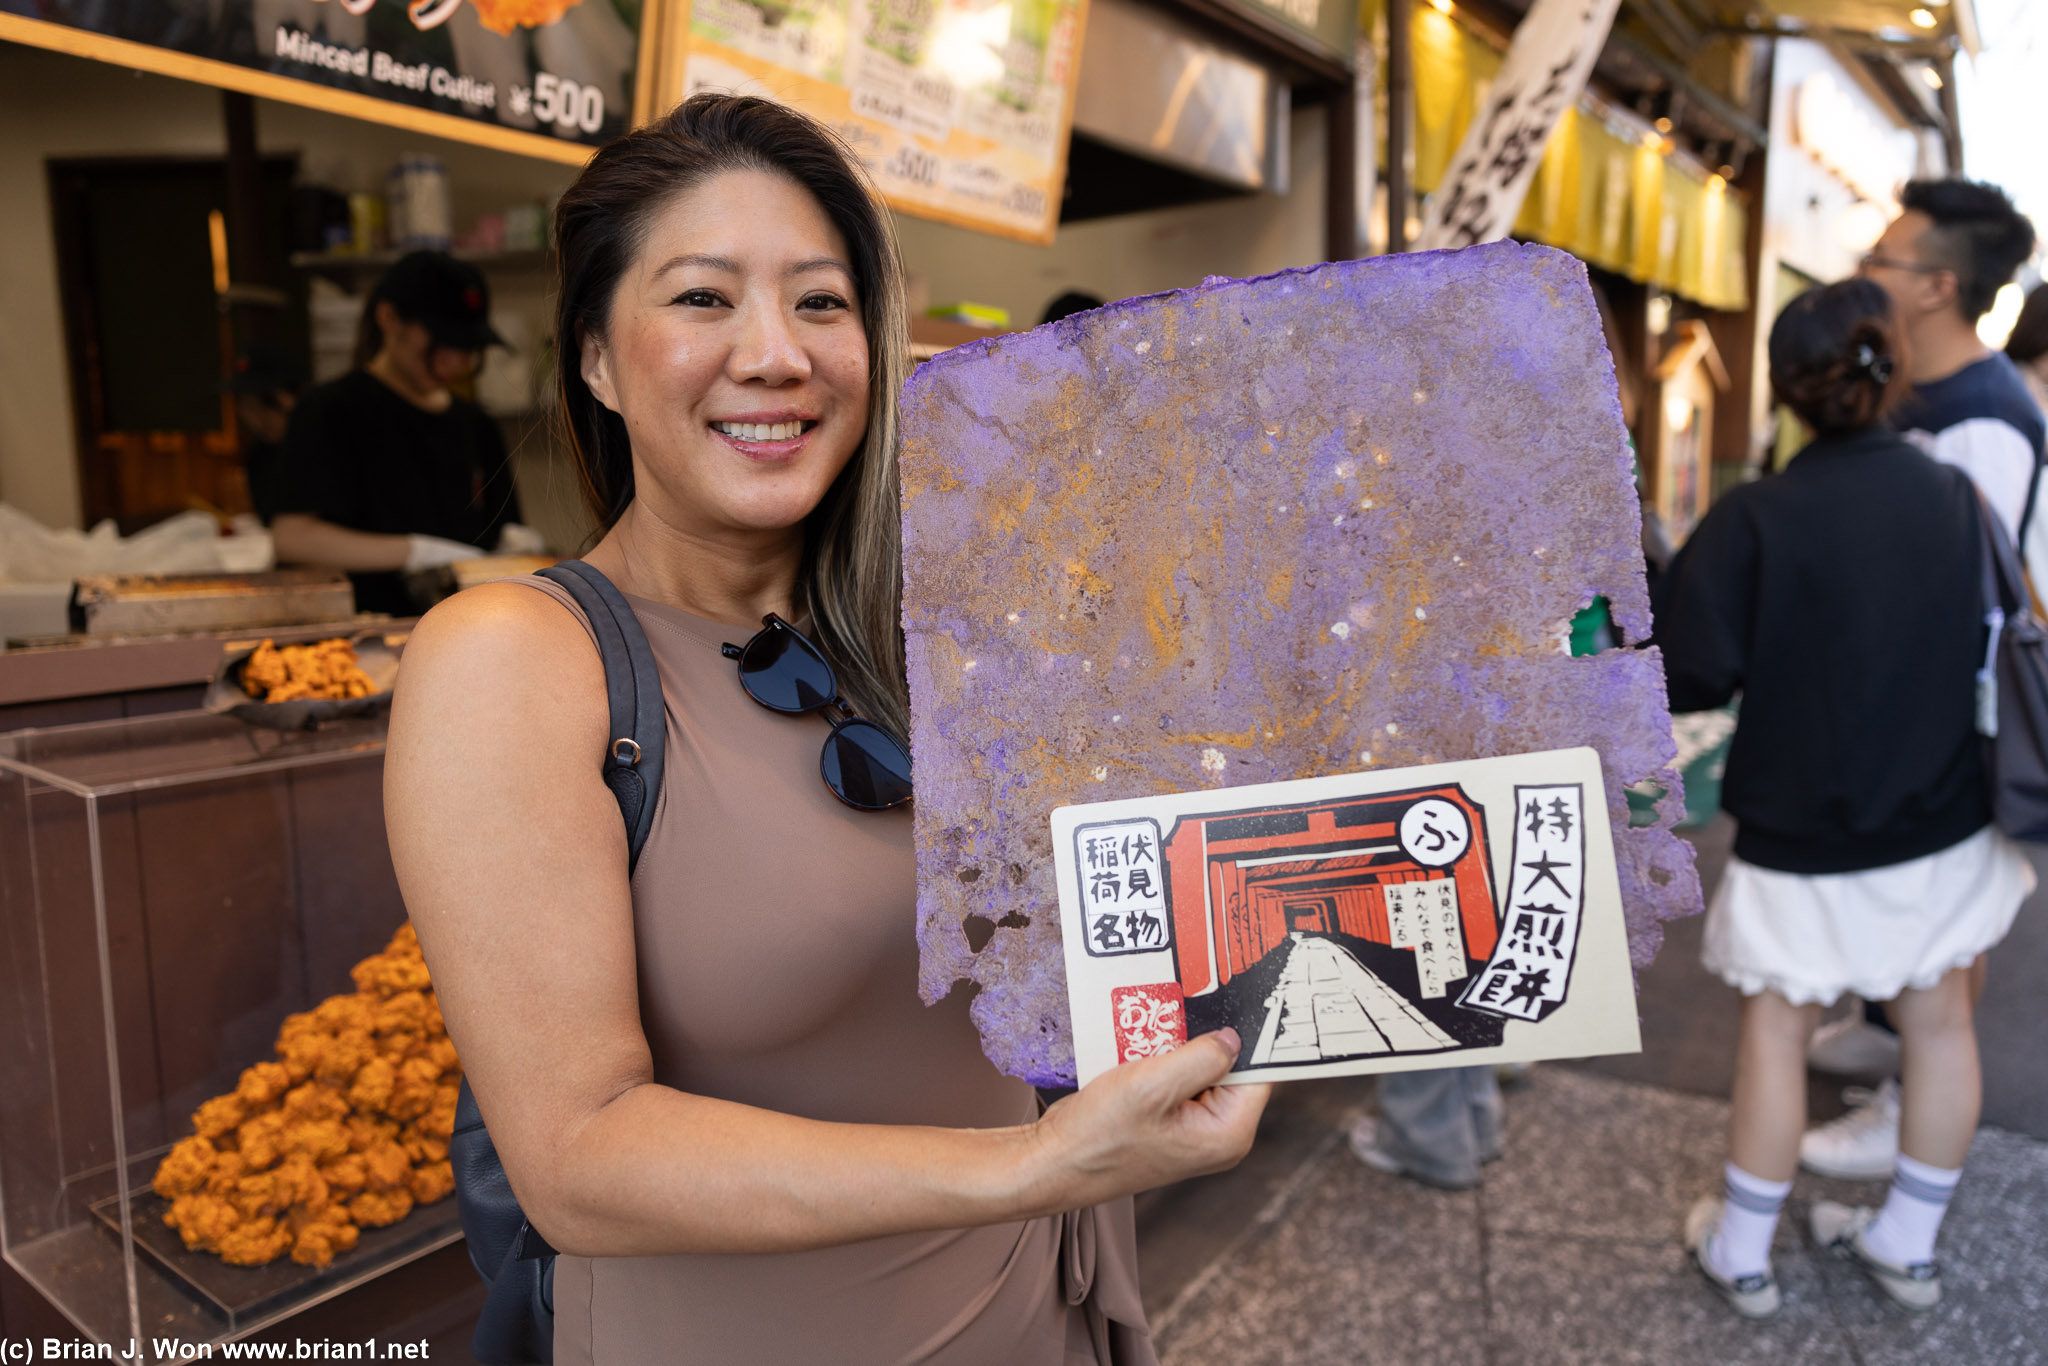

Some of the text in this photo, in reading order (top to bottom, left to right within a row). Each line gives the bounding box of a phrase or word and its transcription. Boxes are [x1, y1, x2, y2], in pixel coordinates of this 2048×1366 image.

[276, 26, 368, 77] Minced
[371, 51, 430, 92] Beef
[430, 67, 496, 108] Cutlet
[1413, 809, 1460, 852] ふ
[1093, 909, 1163, 950] 名物
[1479, 796, 1575, 1014] 特大煎餅
